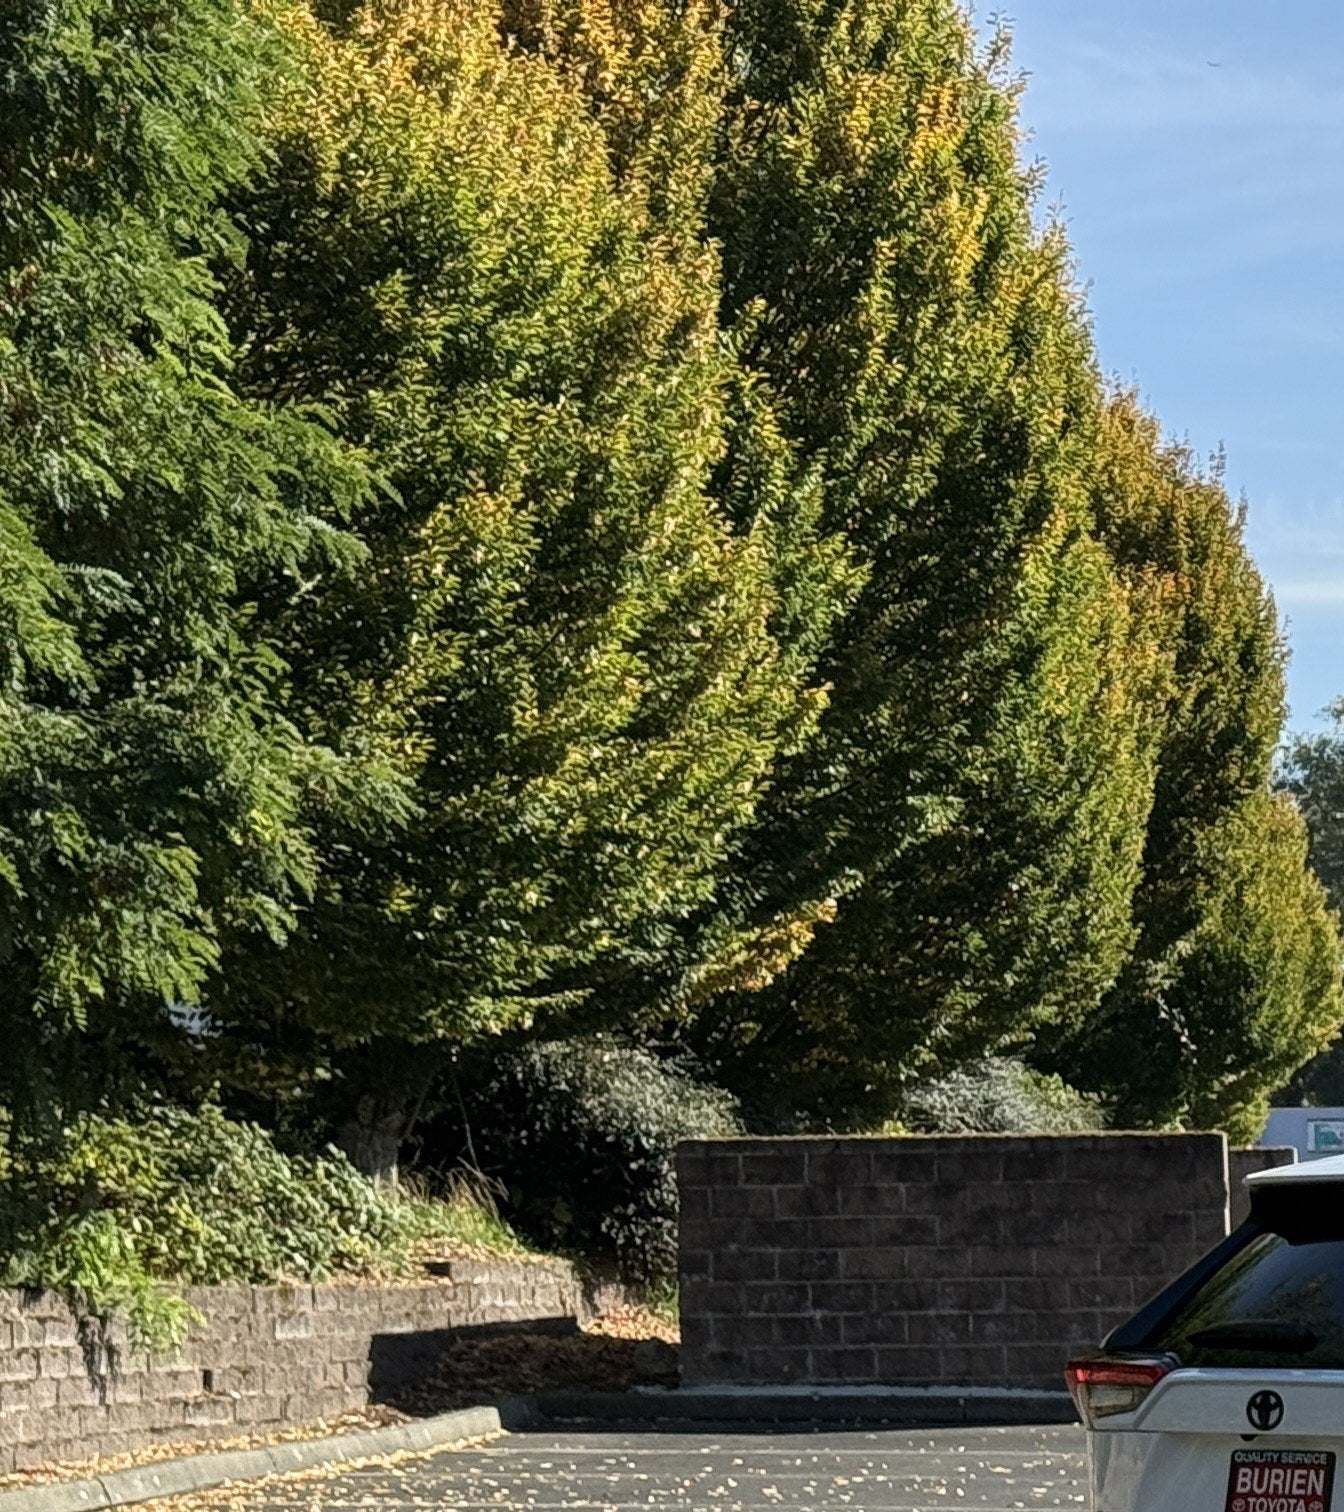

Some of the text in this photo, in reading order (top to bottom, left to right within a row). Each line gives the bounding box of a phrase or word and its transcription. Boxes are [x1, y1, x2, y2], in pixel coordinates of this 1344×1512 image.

[1234, 1451, 1328, 1465] QUALITY SERVICE
[1235, 1467, 1325, 1496] BURIEN
